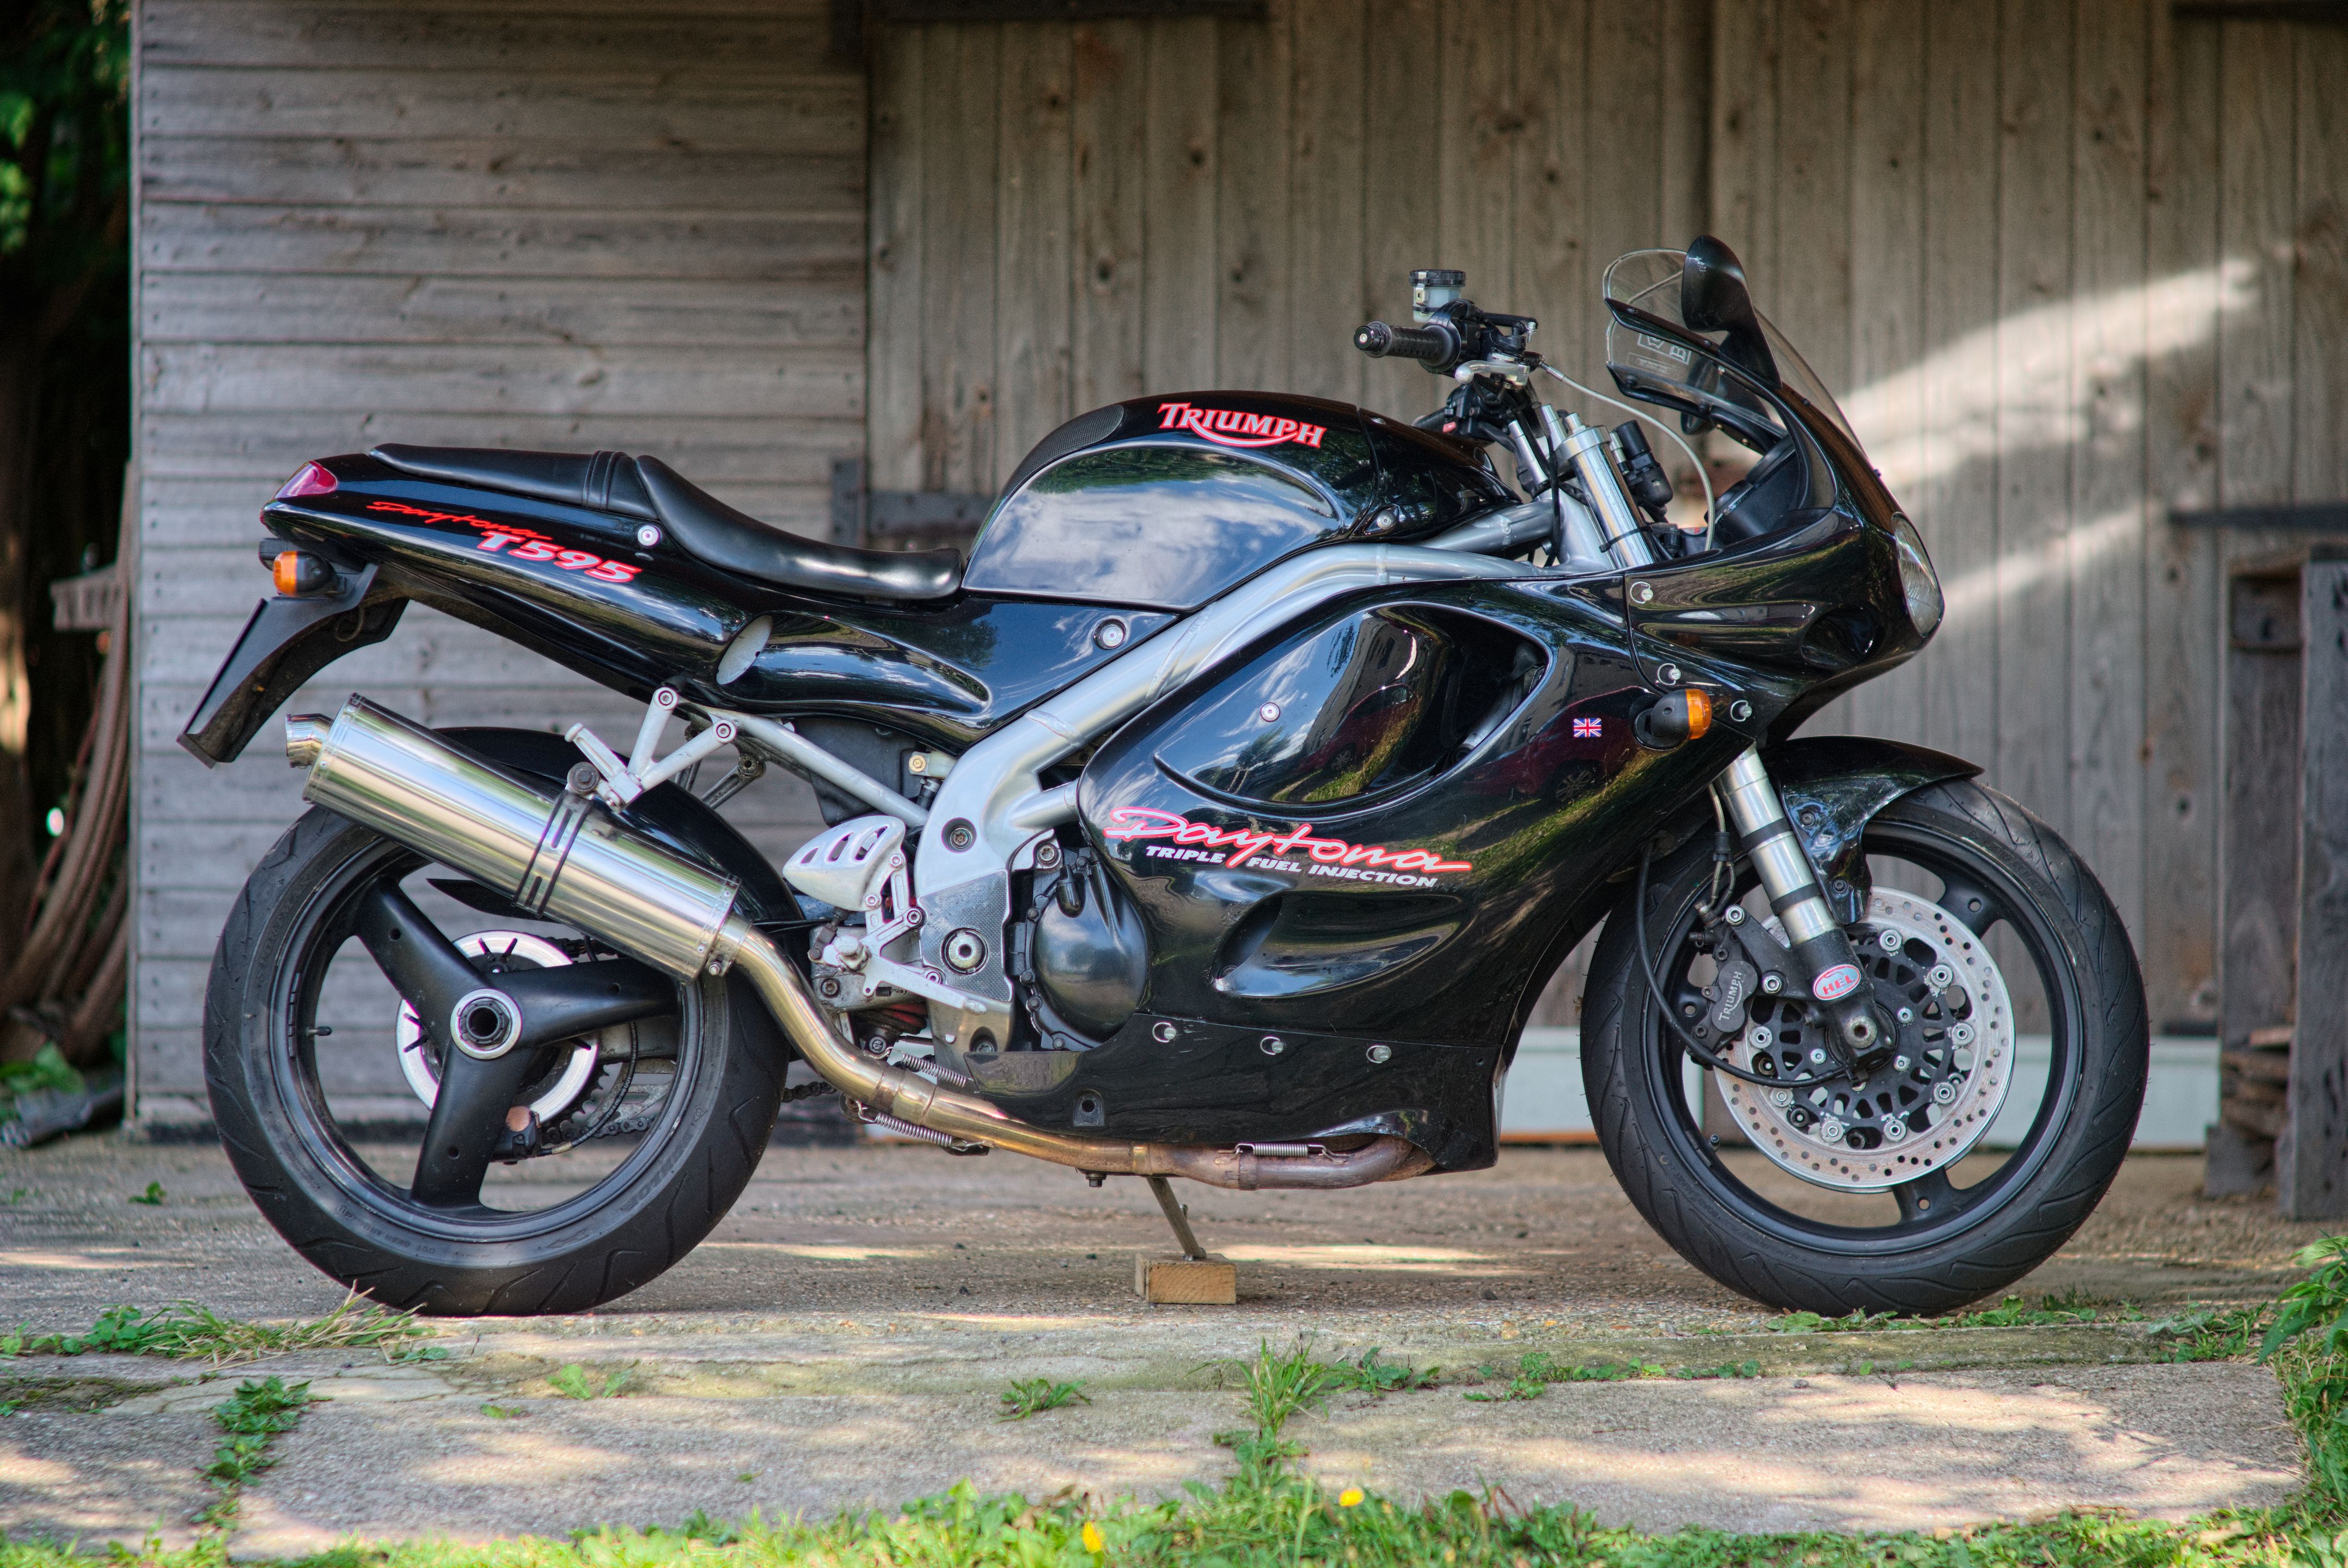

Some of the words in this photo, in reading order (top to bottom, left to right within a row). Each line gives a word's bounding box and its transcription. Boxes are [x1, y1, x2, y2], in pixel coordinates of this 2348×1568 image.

[1158, 402, 1327, 448] TRIUMPH
[366, 501, 552, 541] Daytona
[476, 531, 642, 583] T595
[1103, 806, 1472, 872] Daytona
[1146, 846, 1224, 863] TRIPLE
[1248, 857, 1301, 873] FUEL
[1307, 863, 1438, 888] INJECTION
[1719, 971, 1742, 1021] TRIUMPH
[1822, 975, 1856, 995] HEL
